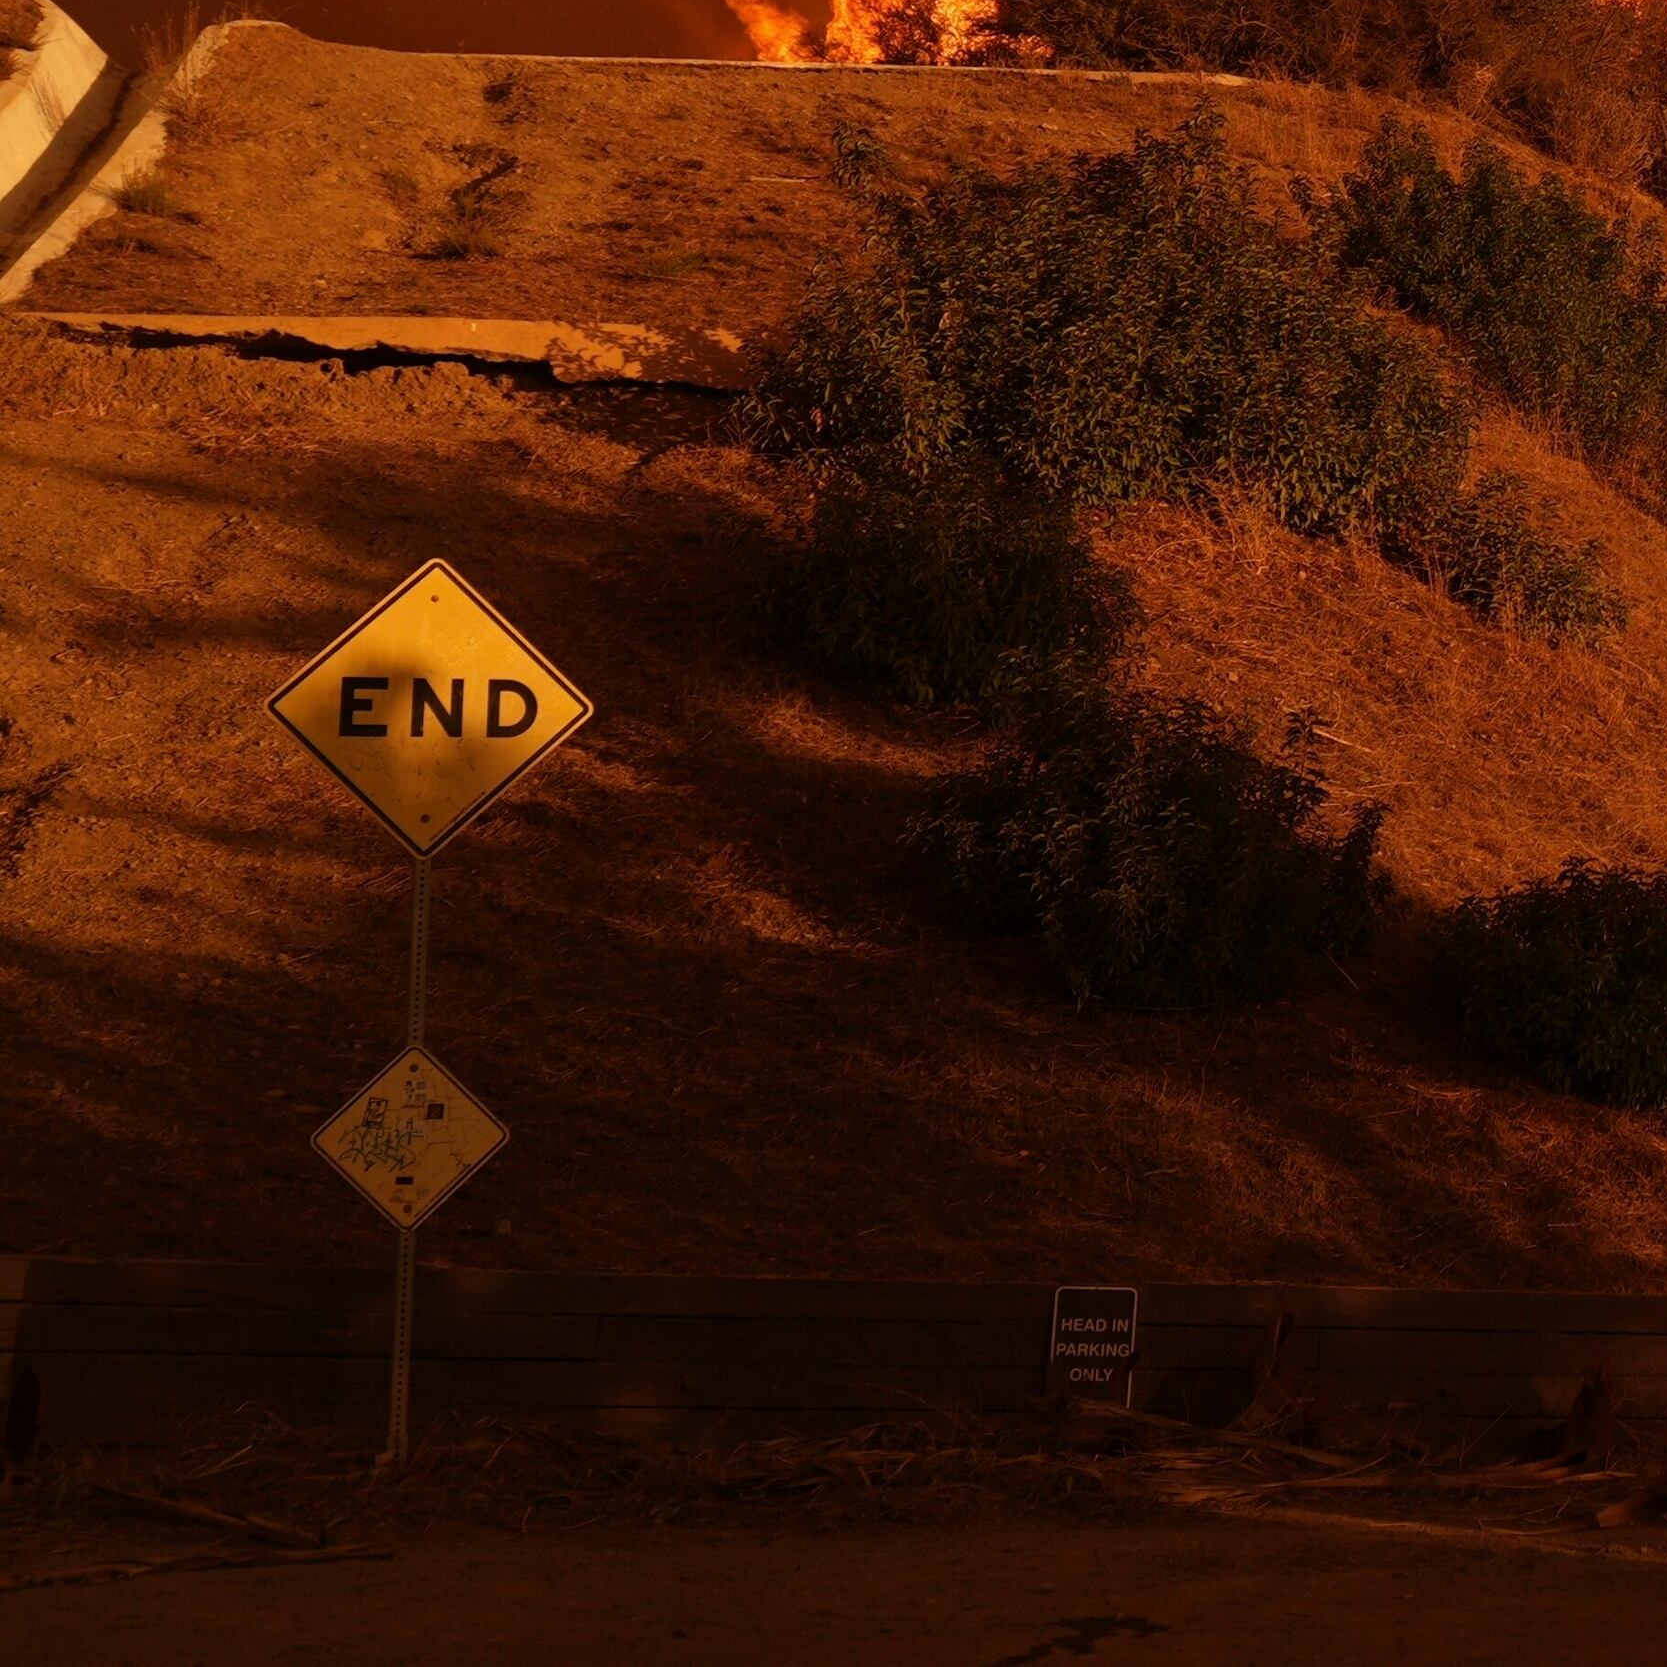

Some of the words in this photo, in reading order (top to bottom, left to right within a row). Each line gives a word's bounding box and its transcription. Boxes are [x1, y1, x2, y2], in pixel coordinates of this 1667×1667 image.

[338, 676, 538, 739] END
[1061, 1318, 1107, 1332] HEAD
[1112, 1319, 1129, 1332] IN
[1056, 1343, 1130, 1357] PARKING
[1070, 1368, 1113, 1382] ONLY
